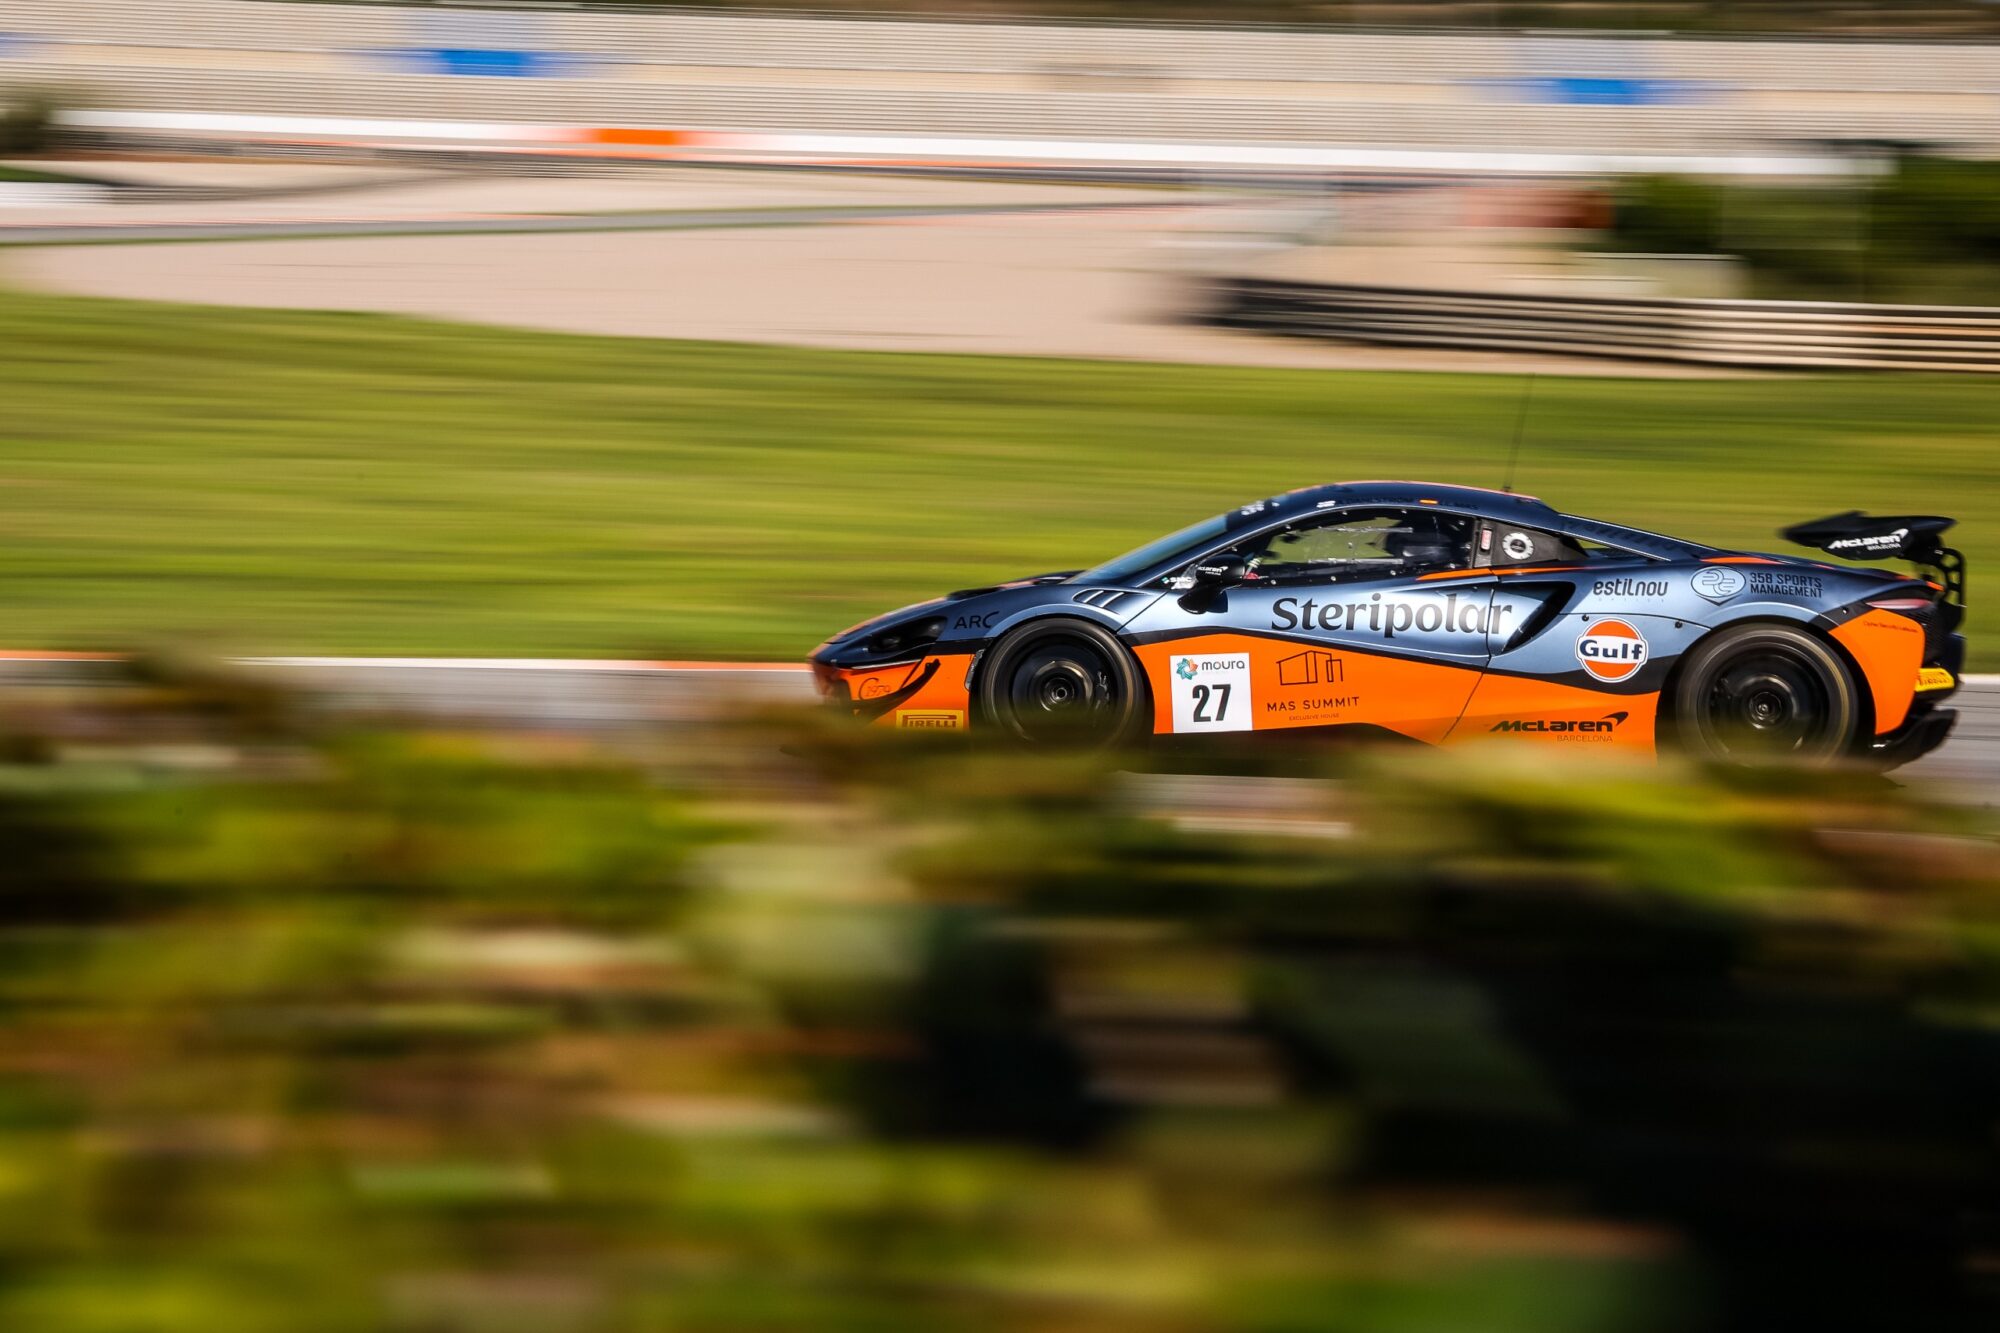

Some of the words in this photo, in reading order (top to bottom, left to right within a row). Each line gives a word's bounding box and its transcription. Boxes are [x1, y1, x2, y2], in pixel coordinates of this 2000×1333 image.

[1828, 534, 1901, 549] McLaren
[1593, 578, 1668, 597] estilnou
[1749, 572, 1773, 584] 358
[1776, 573, 1823, 588] SPORTS
[1750, 583, 1824, 598] MANAGEMENT
[953, 611, 1000, 630] ARC
[1271, 592, 1513, 639] Steripolar
[1579, 639, 1643, 660] Gulf
[1201, 659, 1246, 671] moura
[1191, 683, 1232, 723] 27
[1266, 701, 1297, 712] MAS
[1303, 696, 1360, 709] SUMMIT
[902, 714, 957, 729] PIRELLI
[1489, 720, 1613, 733] McLaren
[1556, 734, 1613, 743] BARCELONA
